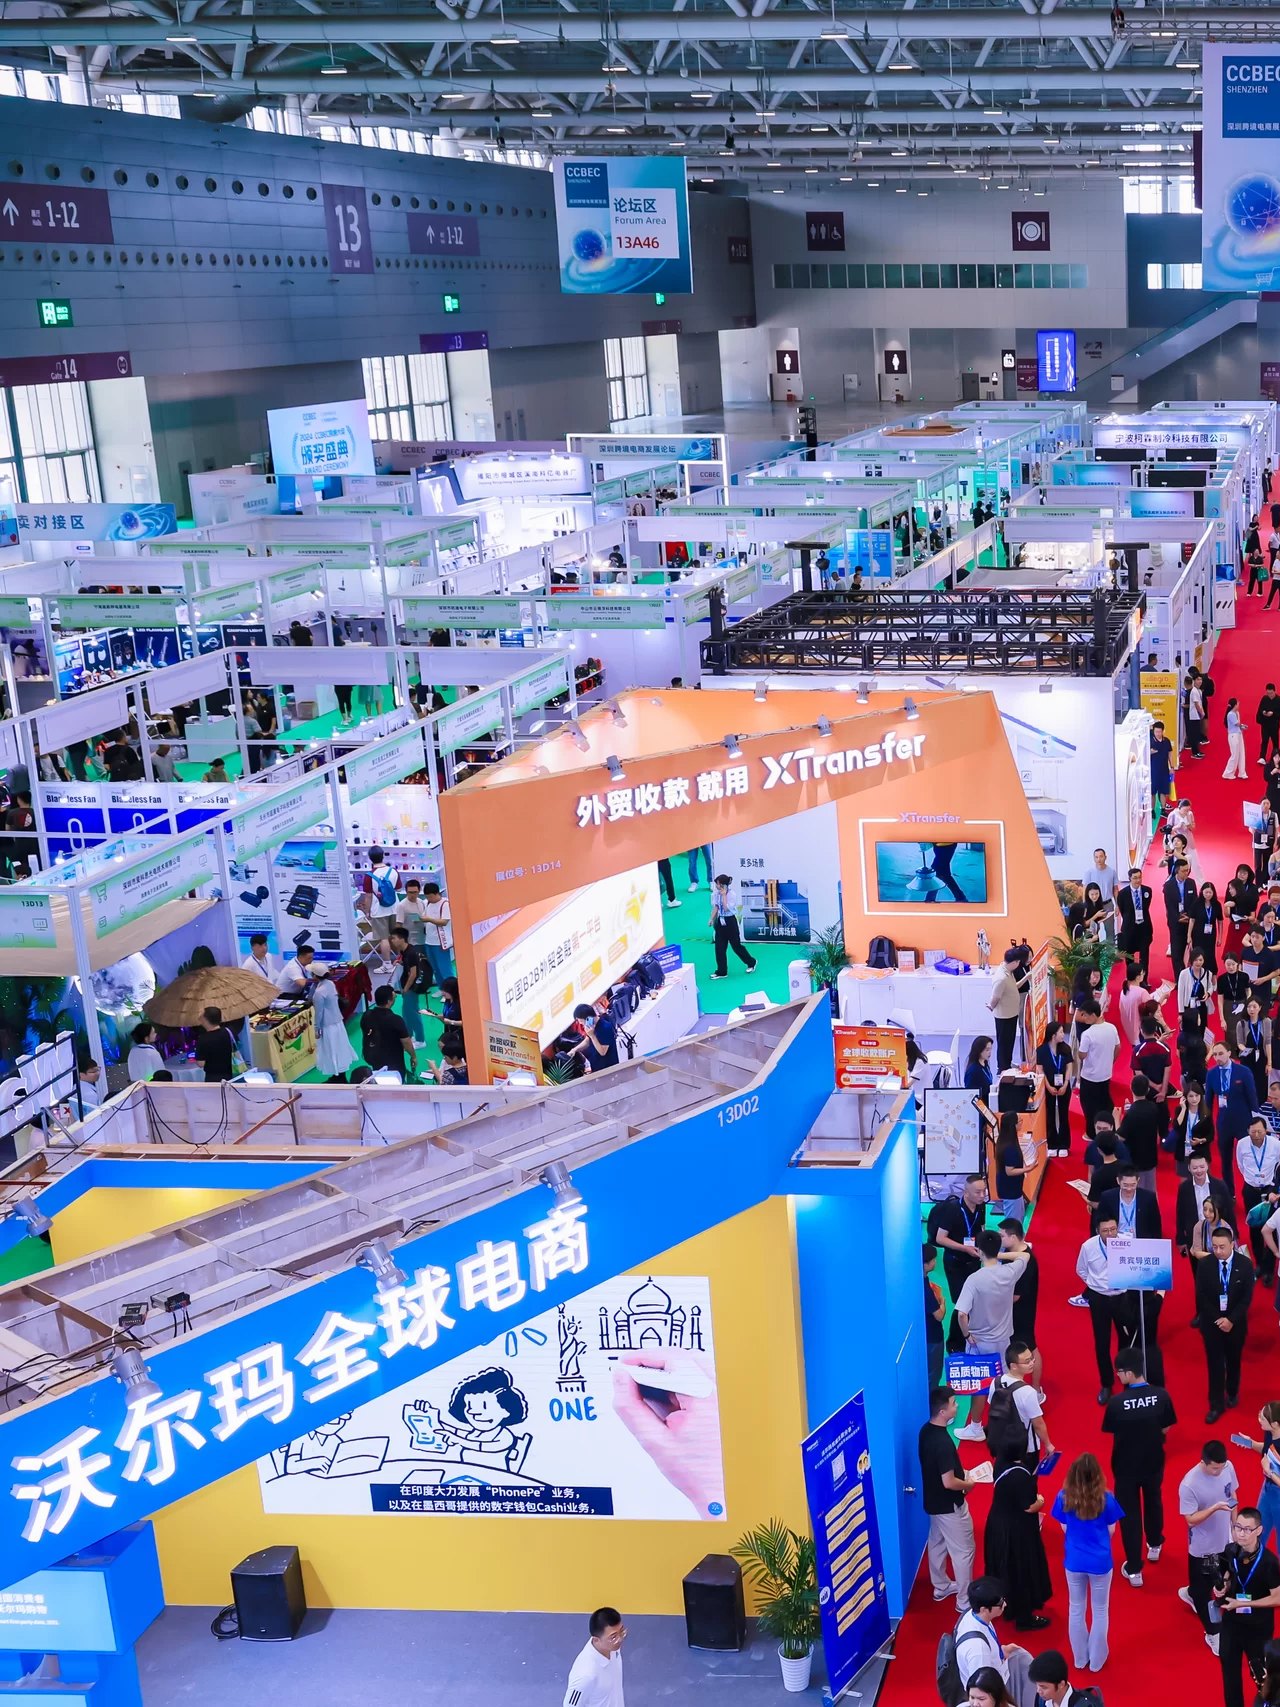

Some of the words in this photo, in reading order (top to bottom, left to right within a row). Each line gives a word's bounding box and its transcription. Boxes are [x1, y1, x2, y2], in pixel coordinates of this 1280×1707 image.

[566, 167, 601, 177] CCBEC
[613, 197, 657, 213] 论坛区
[45, 200, 80, 228] 1-12
[615, 216, 644, 224] Forum
[645, 216, 667, 225] Area
[334, 204, 362, 252] 13
[446, 226, 464, 245] 1-12
[616, 236, 660, 249] 13A46
[454, 335, 463, 350] 13
[62, 358, 78, 380] 14
[50, 371, 63, 381] Gate
[401, 446, 426, 454] CCBEC
[435, 448, 460, 456] CCBEC
[599, 445, 677, 454] 深圳跨境电商发展论坛
[575, 777, 691, 830] 外贸收款
[697, 764, 750, 802] 就用
[761, 731, 926, 790] XTransfer
[46, 794, 83, 803] Blaless
[83, 795, 97, 803] Fan
[148, 795, 162, 804] Fan
[216, 796, 229, 804] Fan
[898, 812, 962, 824] XTransfer
[739, 857, 765, 868] 更多场景
[757, 926, 797, 937] 工厂/仓库场景
[716, 1095, 761, 1128] 13D02
[1119, 1256, 1160, 1266] 贵宾导览团
[10, 1203, 591, 1544] 沃尔玛全球电商
[949, 1365, 991, 1378] 品质物流
[950, 1378, 982, 1392] 选凯琦
[1123, 1395, 1159, 1410] STAFF
[549, 1396, 598, 1422] ONE
[0, 1593, 45, 1604] 国消费者
